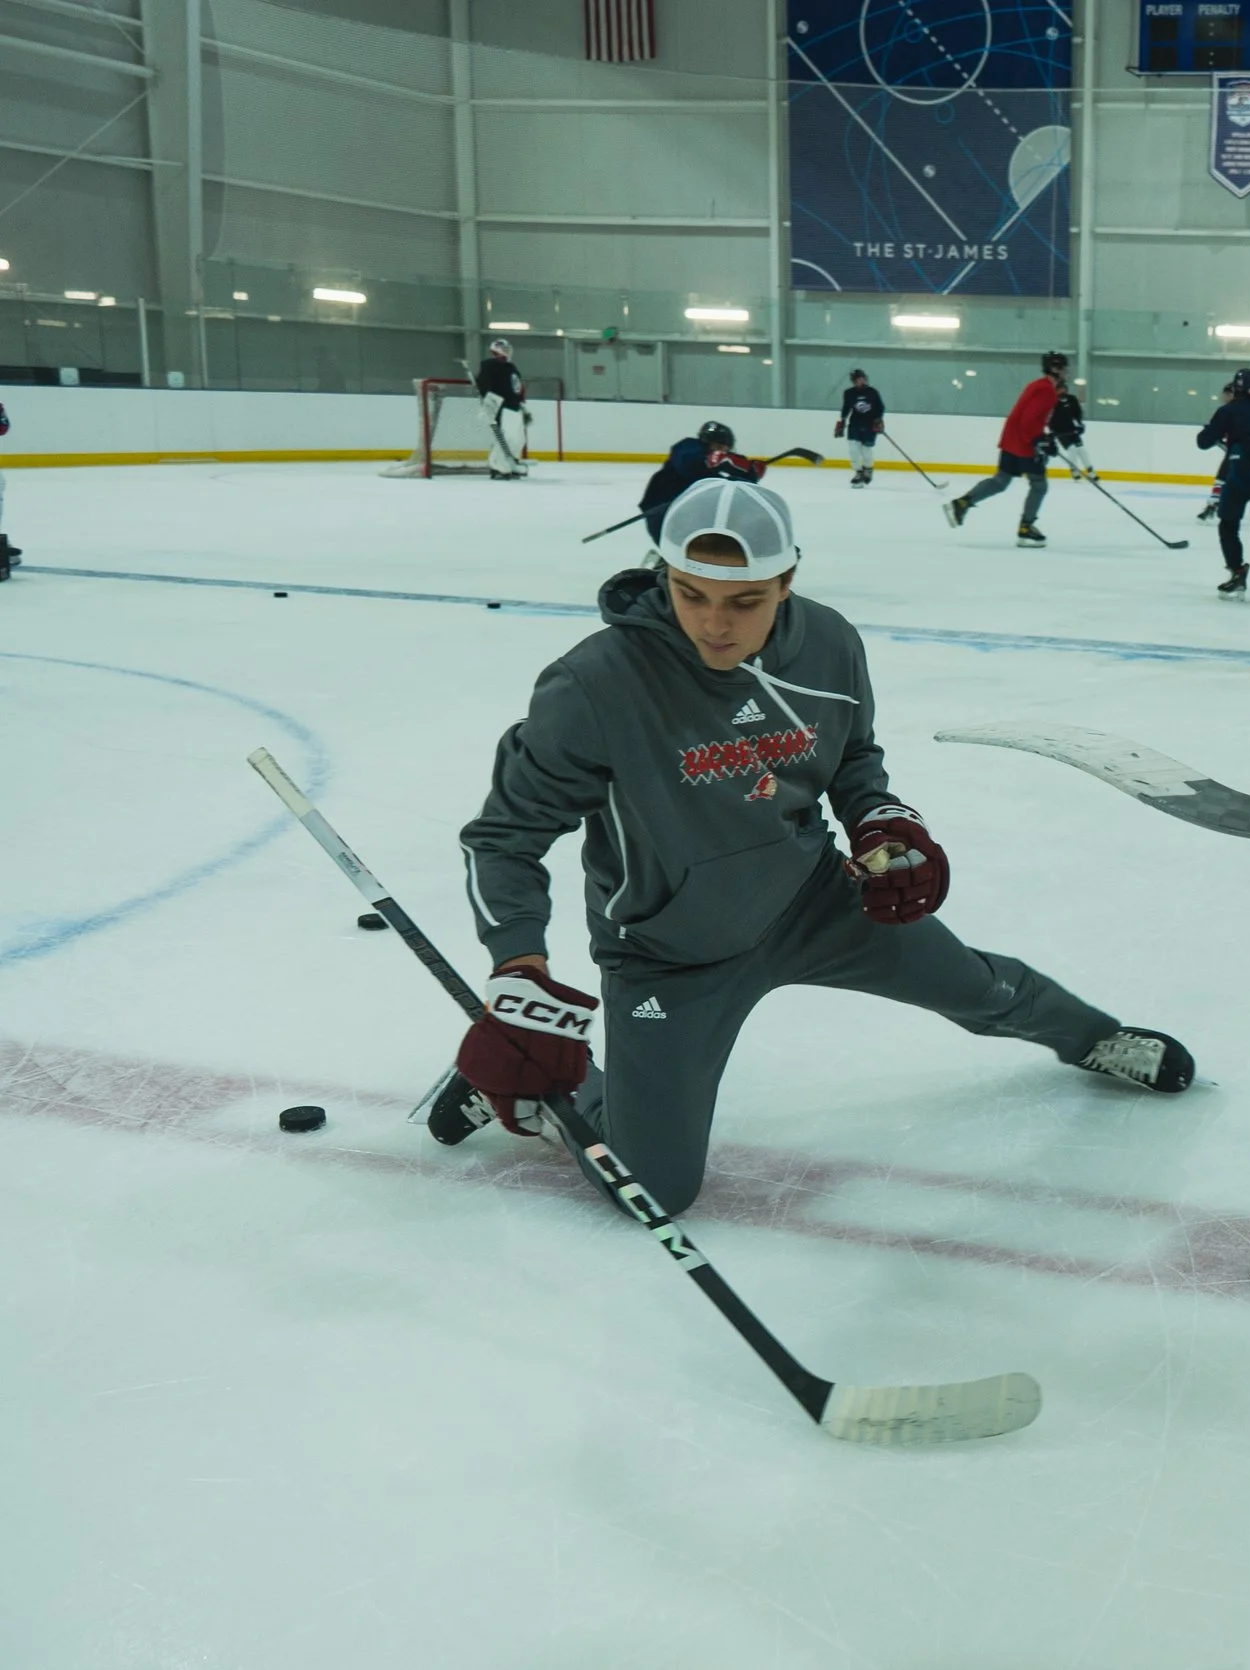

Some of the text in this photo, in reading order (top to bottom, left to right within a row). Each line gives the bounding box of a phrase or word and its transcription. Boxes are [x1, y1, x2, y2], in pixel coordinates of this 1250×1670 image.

[1146, 4, 1183, 16] PLAYER
[1198, 4, 1241, 16] PENALTY
[853, 242, 895, 258] THE
[731, 712, 766, 725] adidas
[493, 994, 593, 1036] CCM
[632, 1009, 667, 1020] adidas
[585, 1143, 710, 1273] CCM
